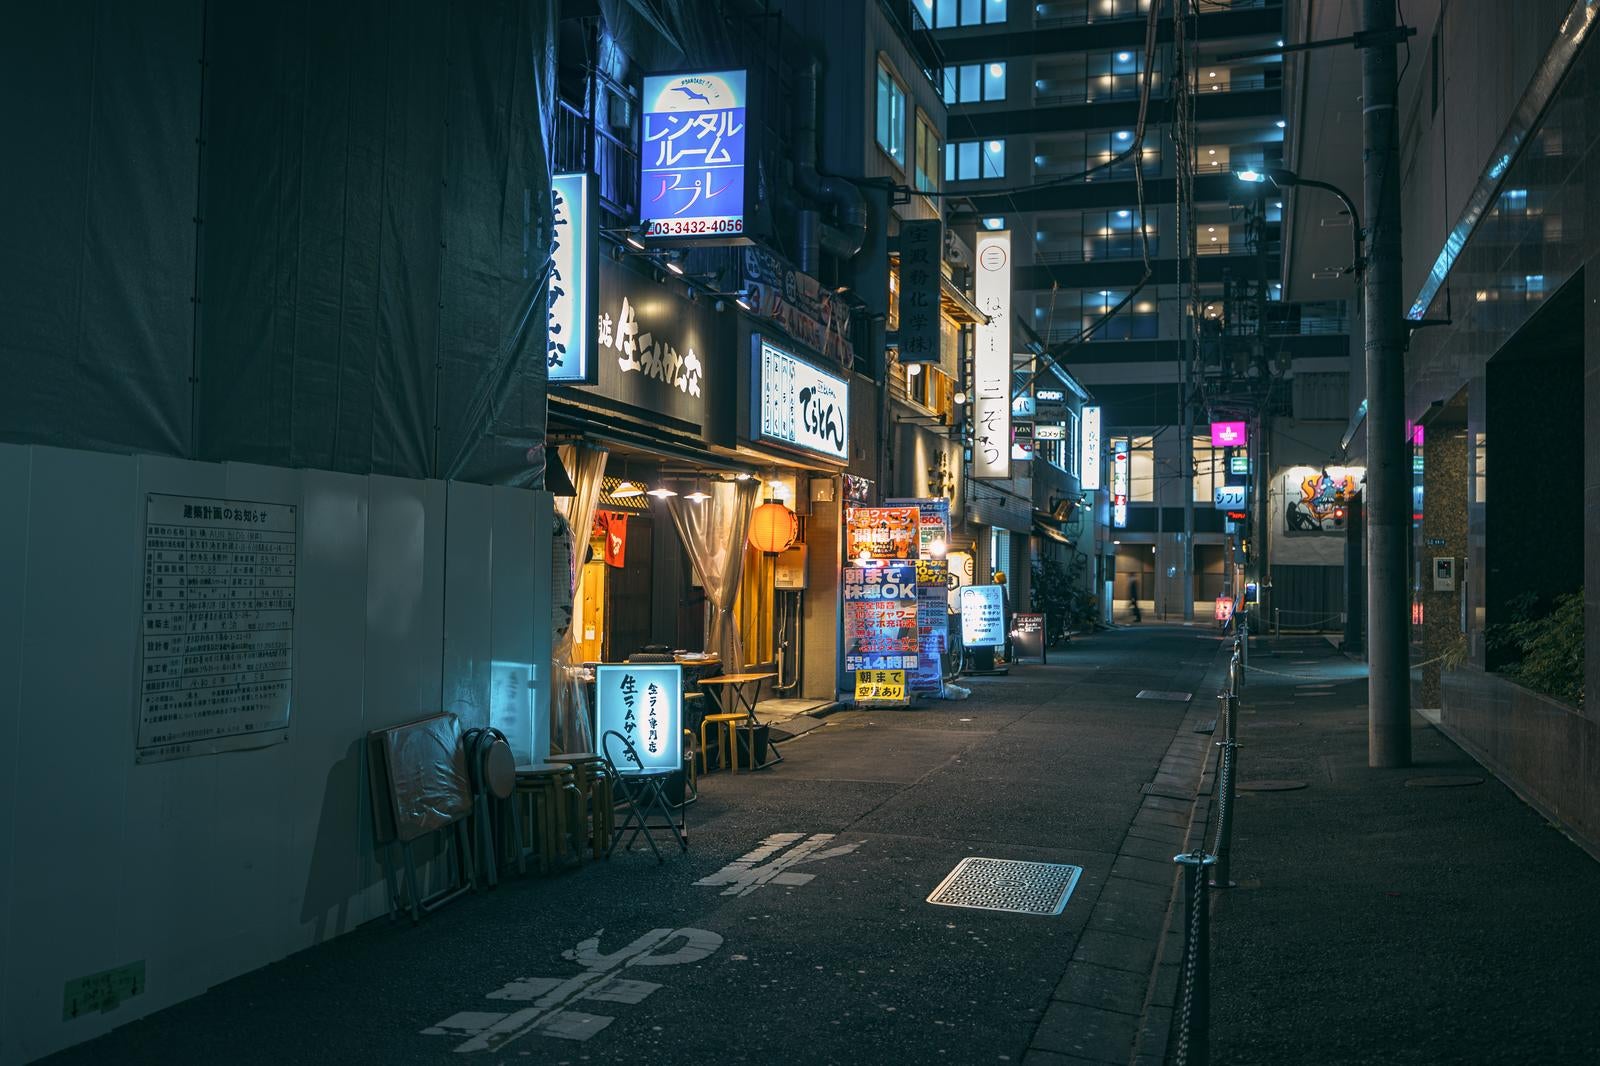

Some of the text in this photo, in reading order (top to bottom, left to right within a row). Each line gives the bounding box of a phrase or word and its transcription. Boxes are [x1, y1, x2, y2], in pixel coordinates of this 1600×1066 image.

[645, 111, 743, 142] レンタル
[656, 136, 731, 166] ルーム
[652, 172, 735, 215] アプレ
[654, 219, 742, 235] 03-3432-4056
[183, 504, 268, 523] 建築計画のお知らせ
[845, 568, 901, 584] 朝まで
[844, 584, 915, 599] 休憩OK
[860, 672, 902, 683] 朝まで
[859, 686, 902, 698] 空室あり
